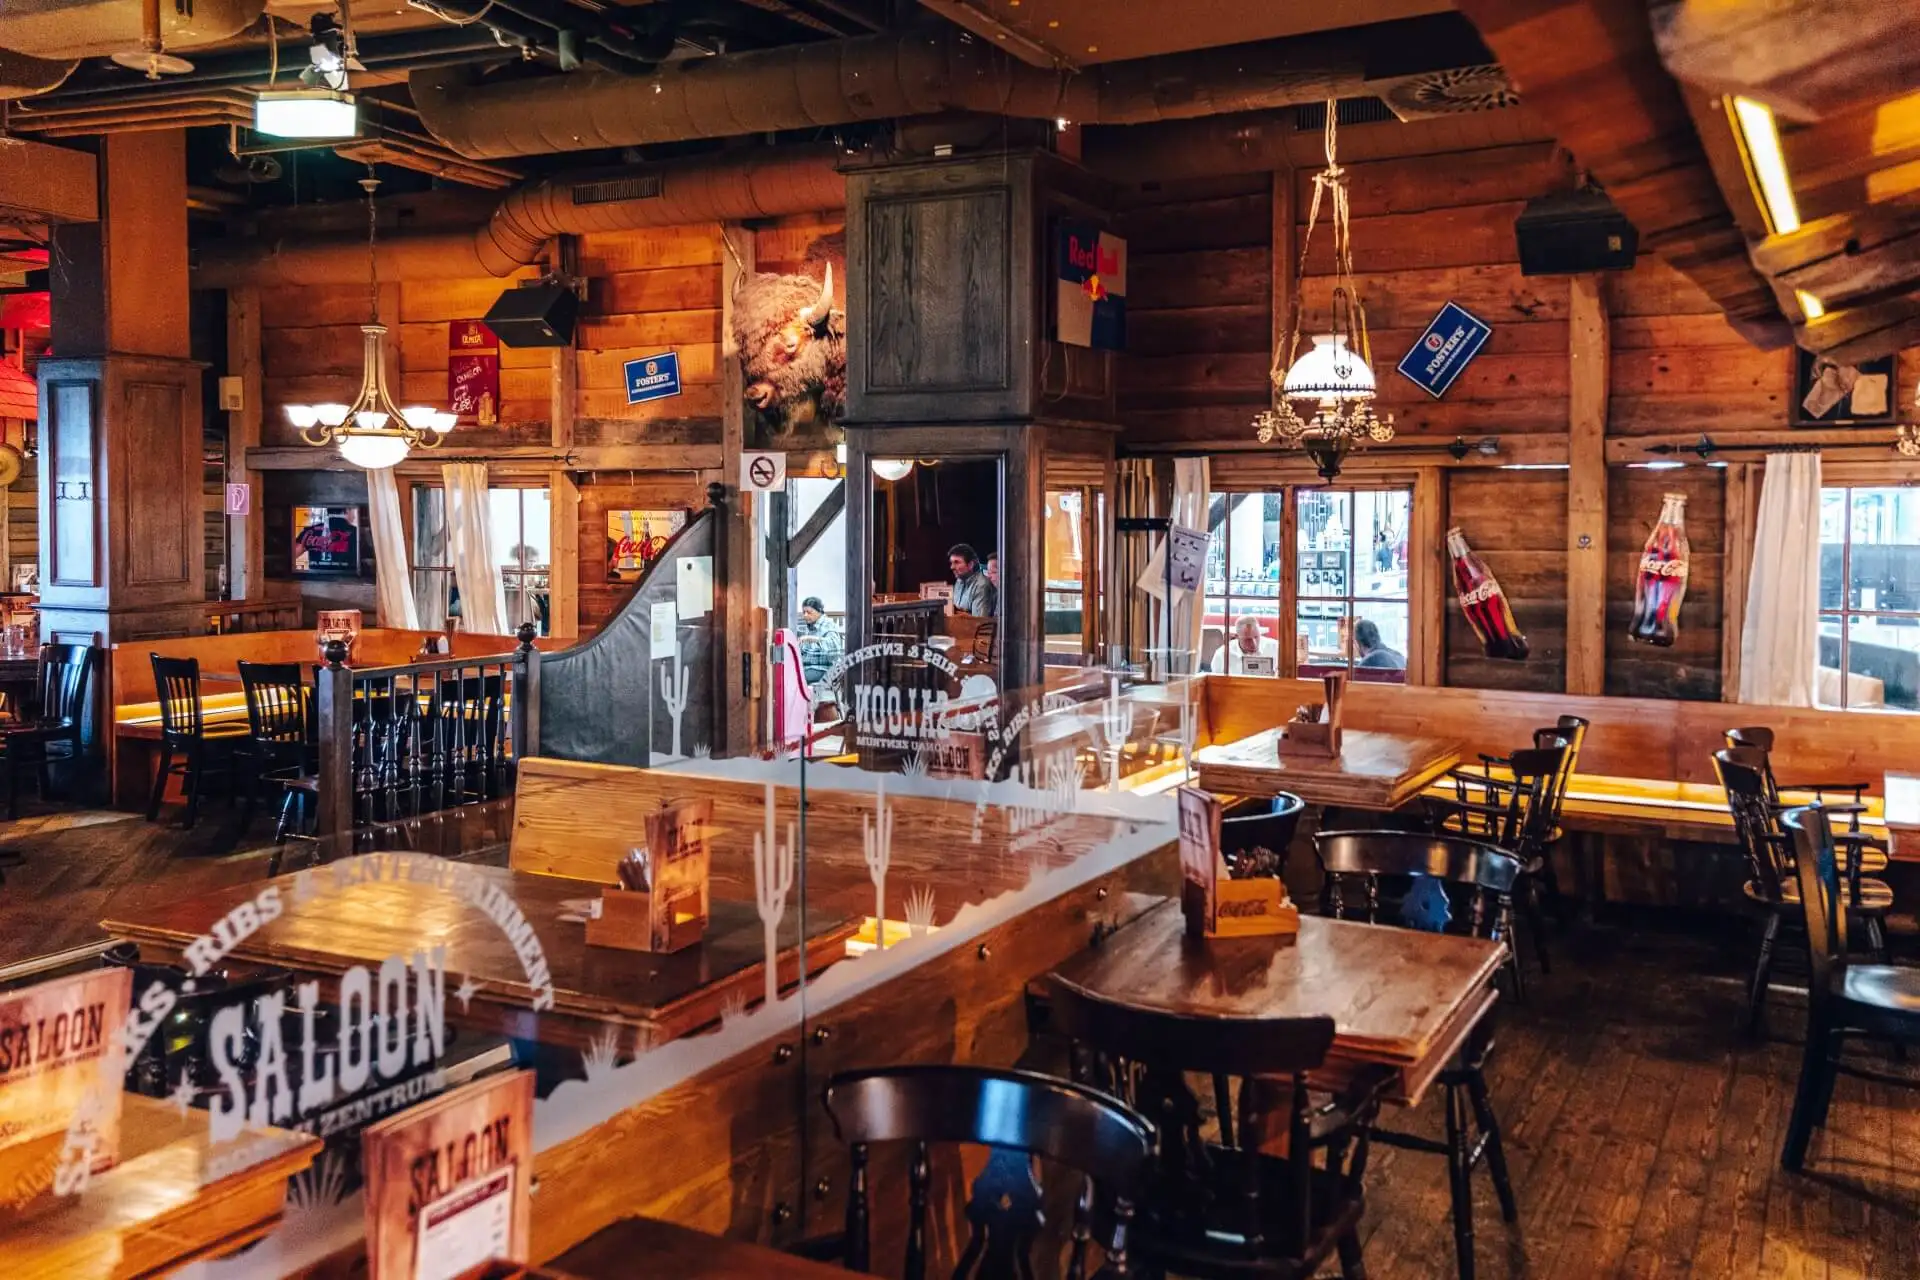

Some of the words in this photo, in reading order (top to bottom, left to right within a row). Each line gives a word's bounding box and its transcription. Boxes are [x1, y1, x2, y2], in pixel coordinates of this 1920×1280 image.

[1069, 235, 1096, 270] Red
[1426, 325, 1466, 375] FOSTER'S
[301, 529, 350, 553] Coca-C
[612, 535, 668, 561] Coca-C
[184, 885, 284, 979] RIBS
[0, 1002, 105, 1076] SALOON
[209, 945, 447, 1146] SALOON
[407, 1114, 511, 1217] SALOON
